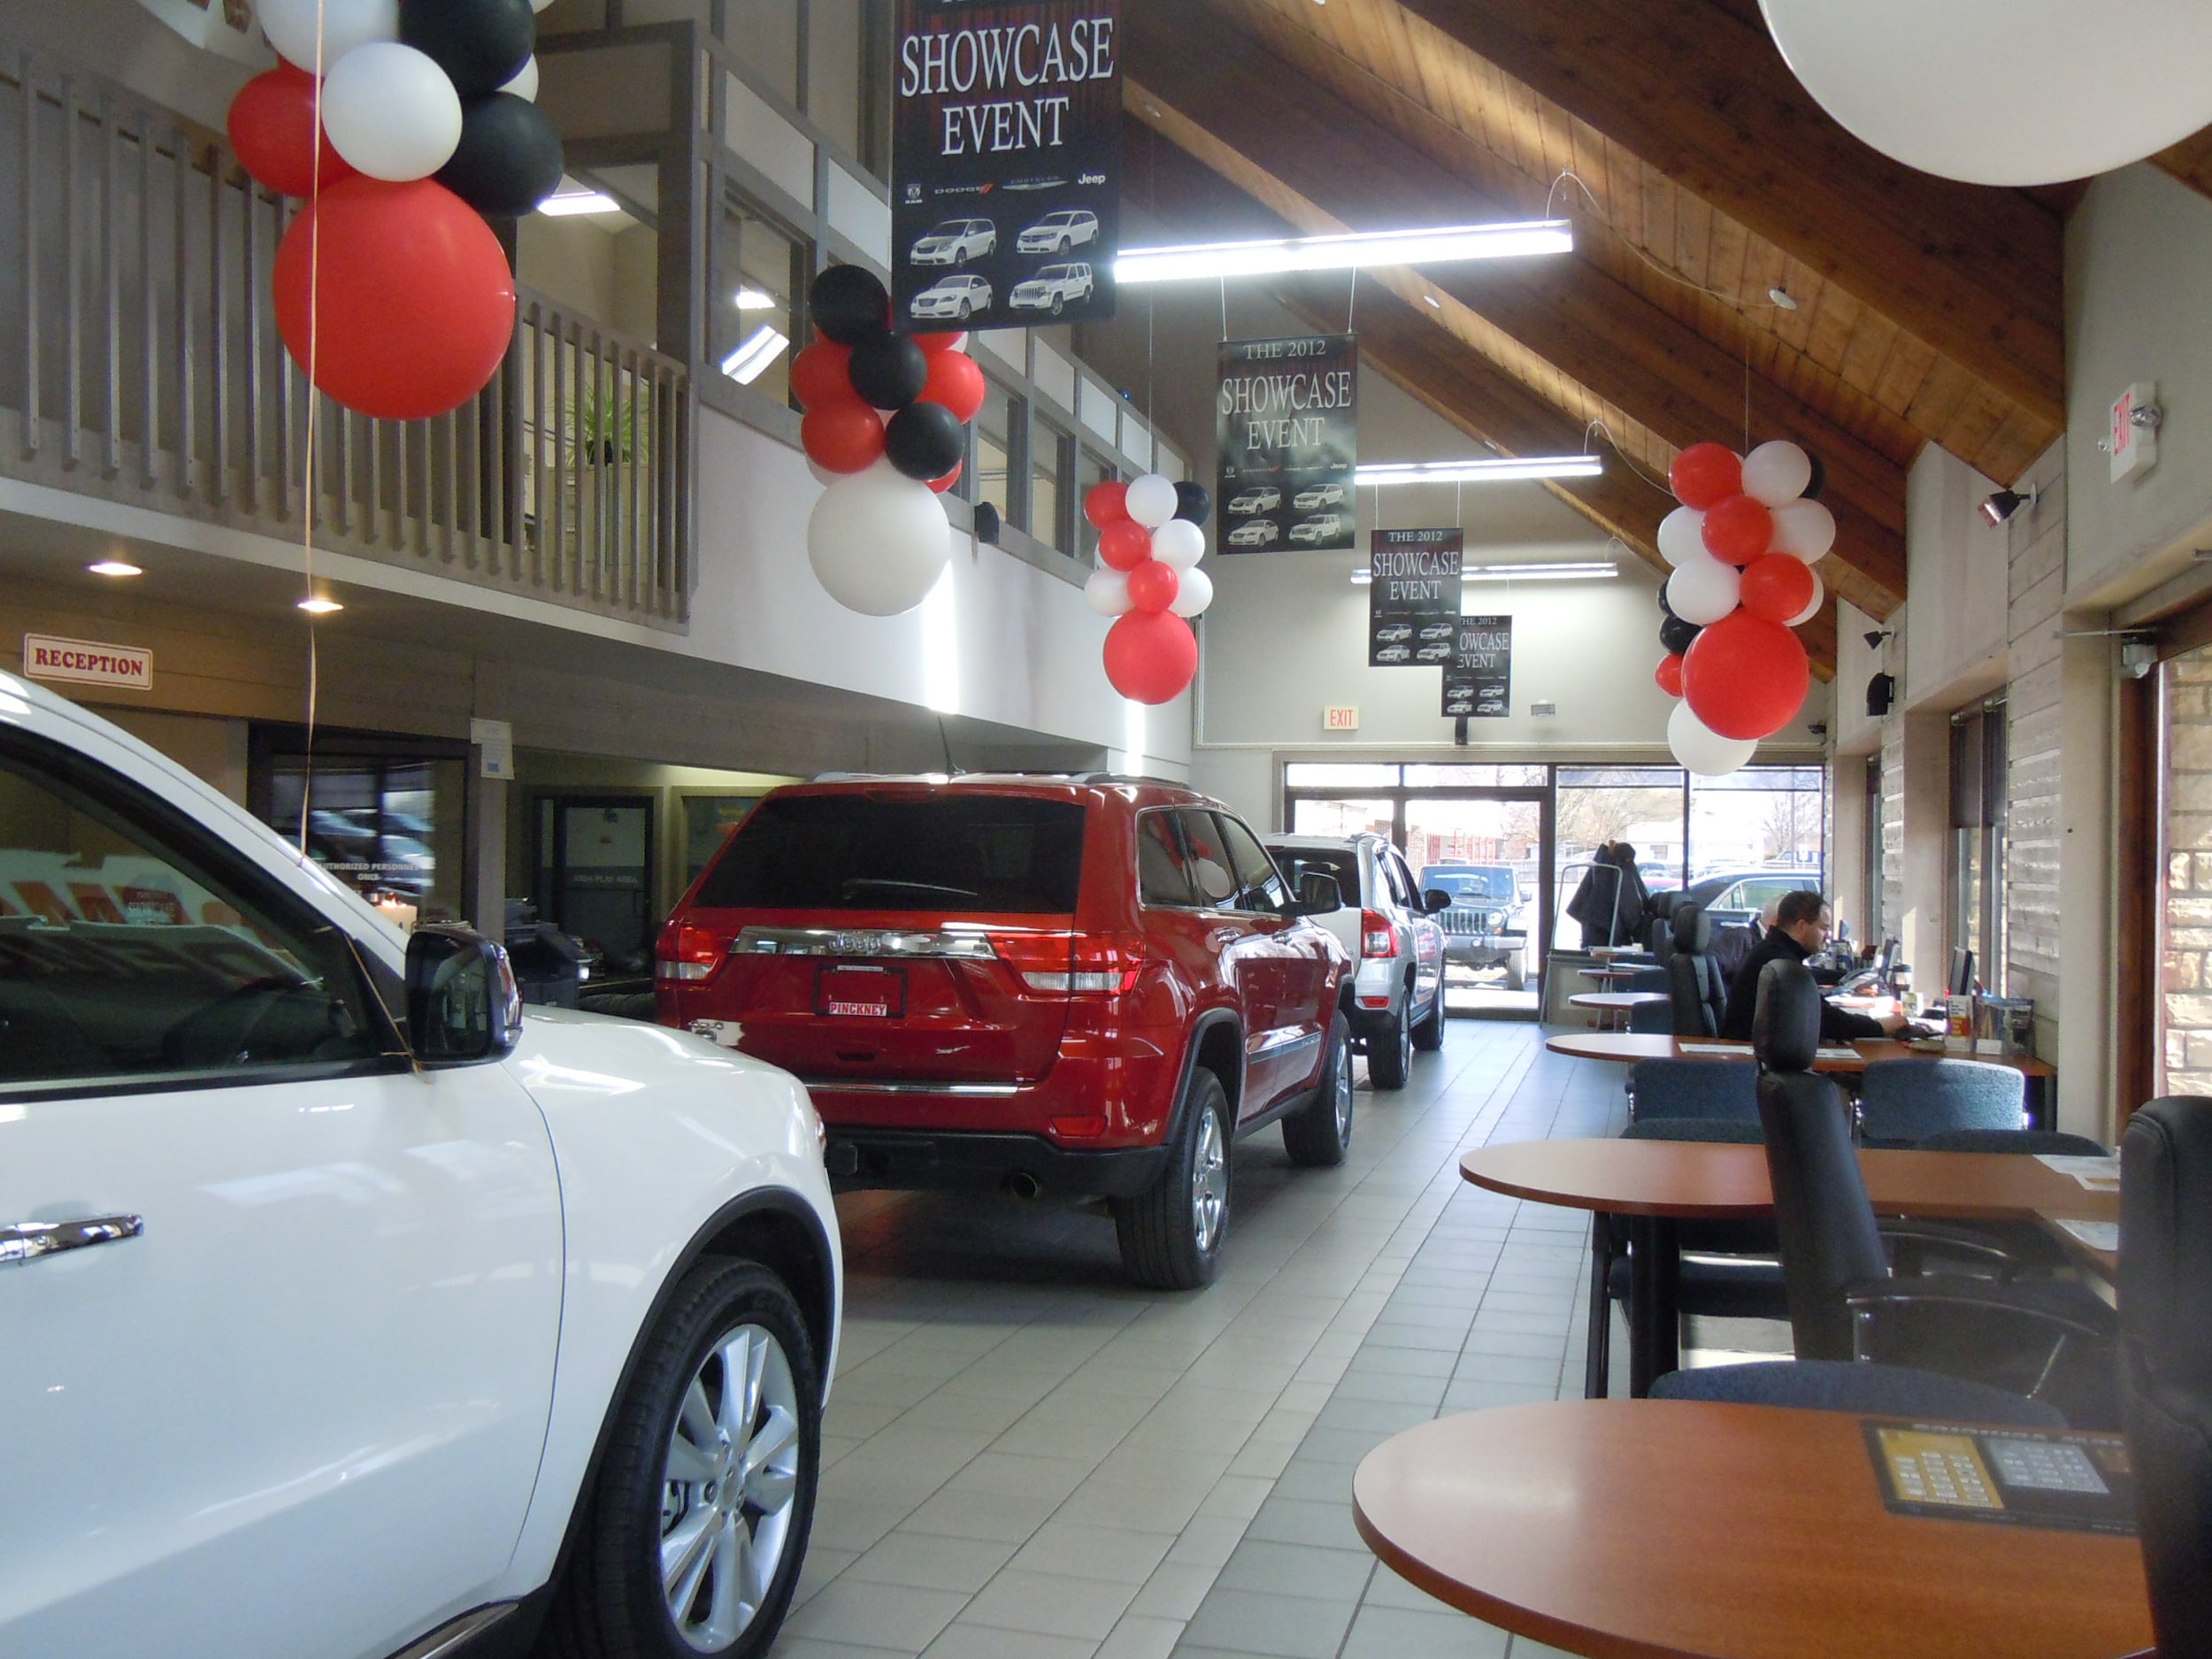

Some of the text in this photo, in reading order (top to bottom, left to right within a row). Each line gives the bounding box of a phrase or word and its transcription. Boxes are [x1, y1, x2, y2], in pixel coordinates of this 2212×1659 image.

[901, 18, 1114, 97] SHOWCASE
[941, 96, 1069, 156] EVENT
[1078, 173, 1106, 186] Jeep
[1243, 340, 1326, 359] THE 2012
[1222, 372, 1351, 415] SHOWCASE
[1247, 417, 1325, 450] EVENT
[1388, 531, 1443, 542] THE 2012
[1373, 551, 1460, 578] SHOWCASE
[1390, 580, 1442, 601] EVENT
[1479, 617, 1497, 626] 2012
[1460, 632, 1509, 651] OWCASE
[35, 648, 142, 676] RECEPTION
[1330, 709, 1353, 726] EXIT
[829, 933, 881, 956] Jeep
[830, 1003, 886, 1016] PINCKNEY
